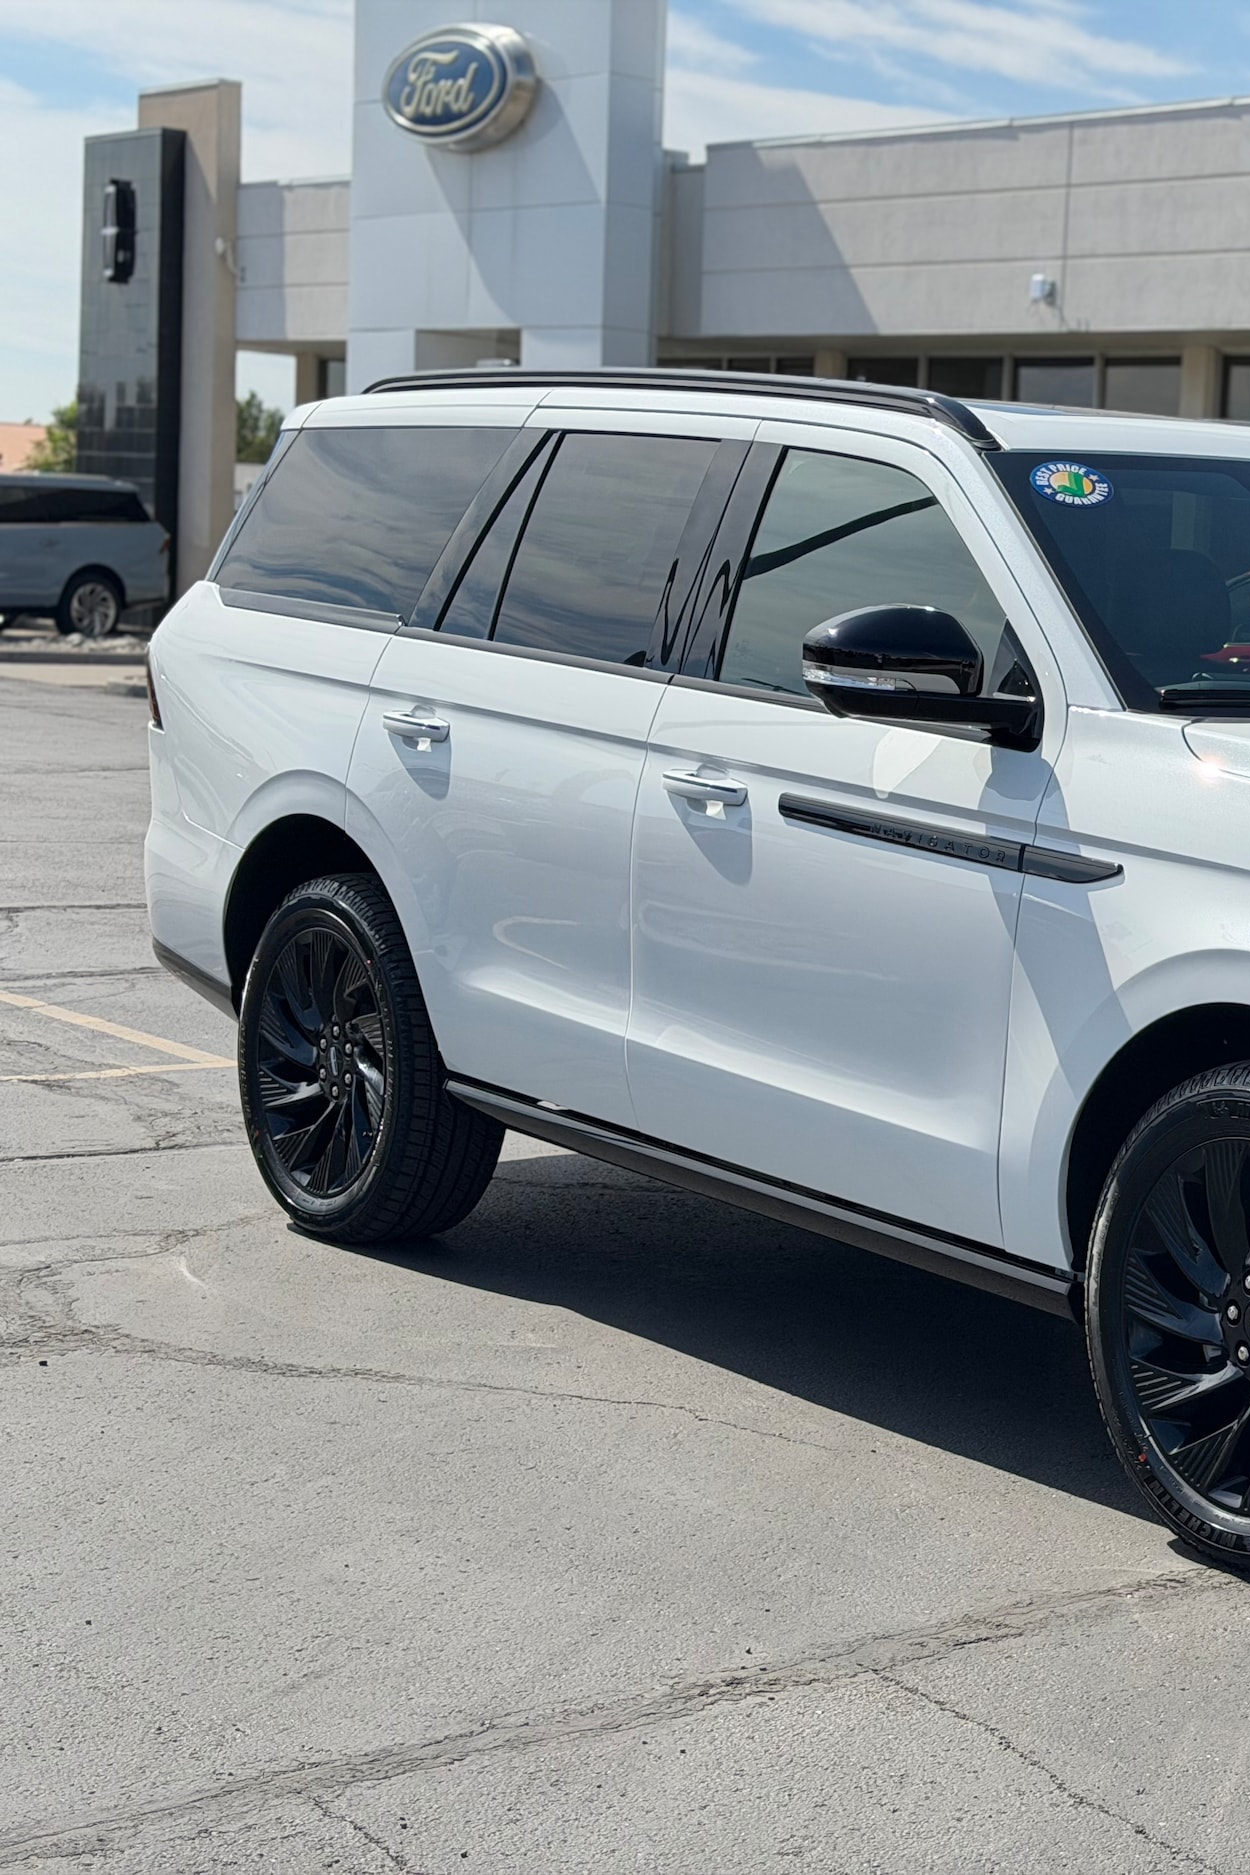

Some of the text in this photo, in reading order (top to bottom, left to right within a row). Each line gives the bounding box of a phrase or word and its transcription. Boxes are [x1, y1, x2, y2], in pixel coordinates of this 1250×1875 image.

[401, 50, 478, 119] Ford
[1035, 463, 1088, 485] BEST PRICE
[1055, 482, 1109, 505] GUARANTEE
[869, 822, 1007, 864] NAVIGATOR
[1149, 1479, 1238, 1549] MICHELIN
